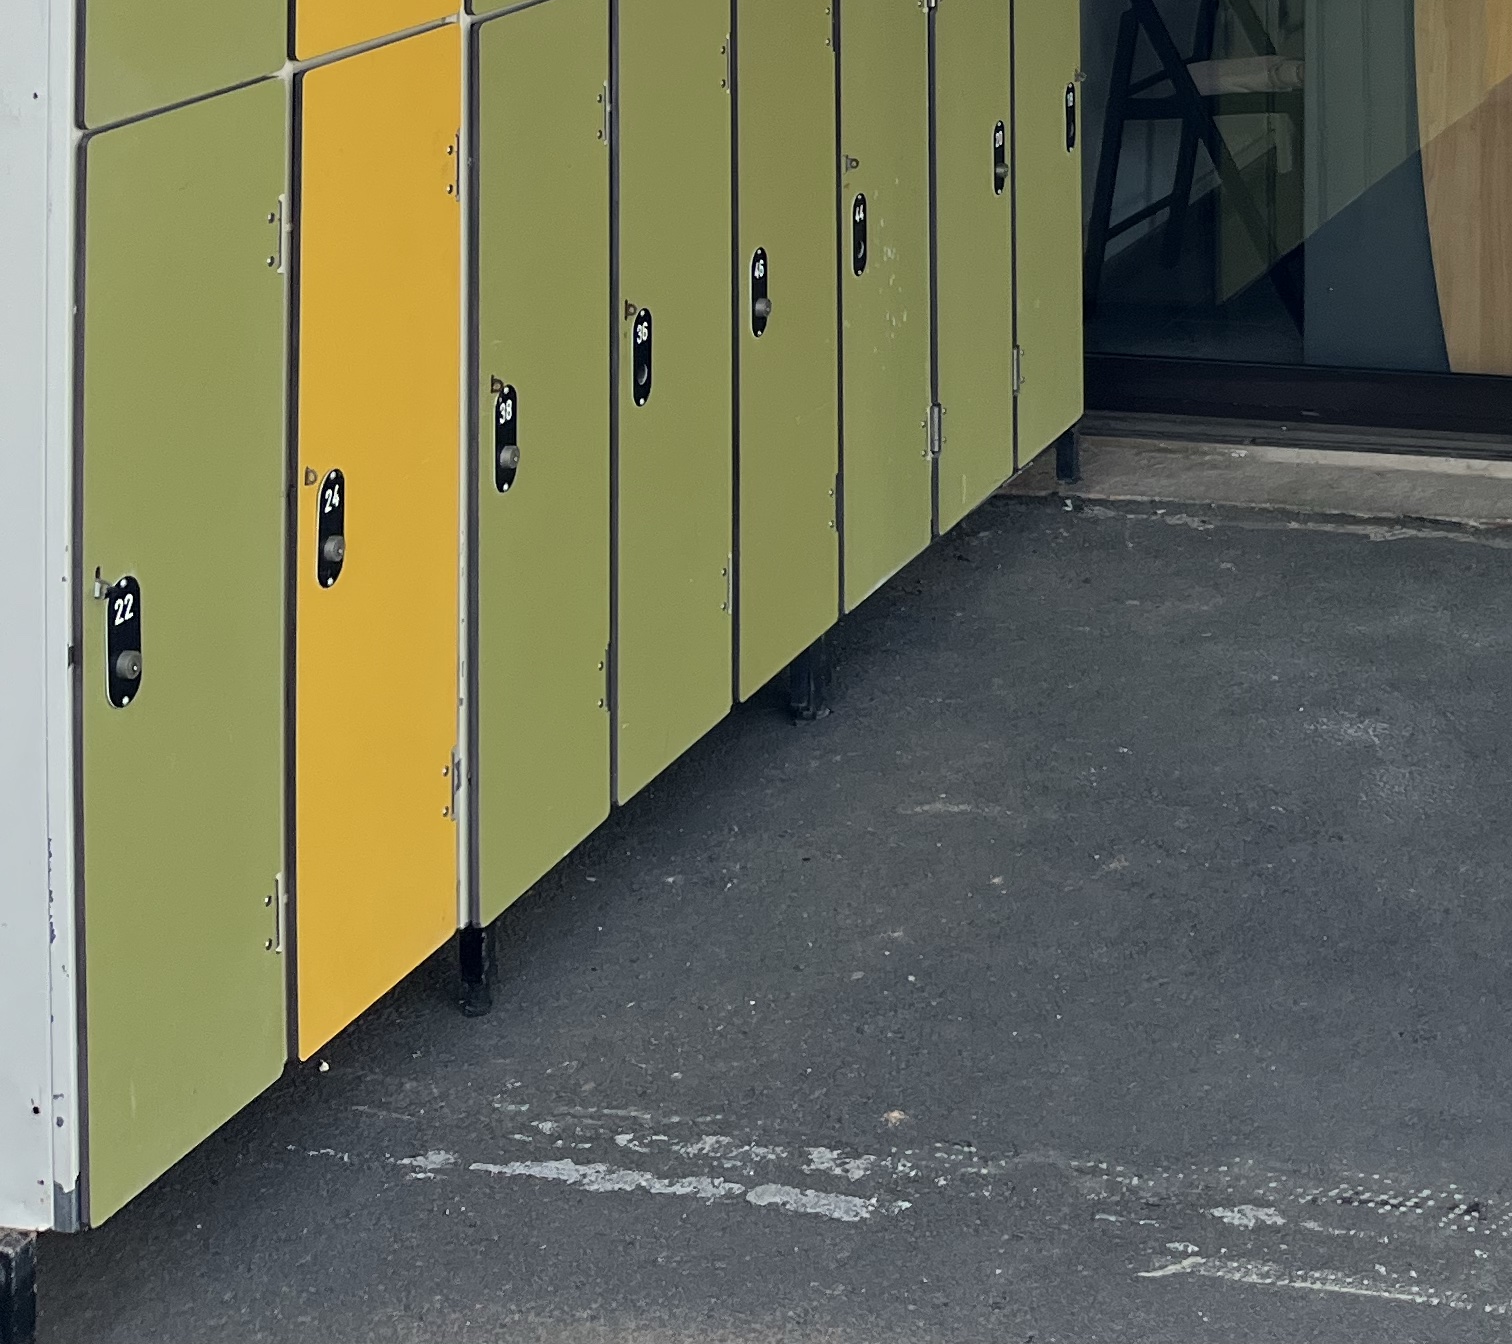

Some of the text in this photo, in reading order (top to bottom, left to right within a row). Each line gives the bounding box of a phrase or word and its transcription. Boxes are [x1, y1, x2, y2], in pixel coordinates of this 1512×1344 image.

[854, 205, 864, 223] 44
[754, 259, 765, 279] 46
[636, 321, 648, 344] 36
[499, 400, 513, 424] 38
[324, 484, 340, 514] 24
[114, 593, 134, 626] 22
